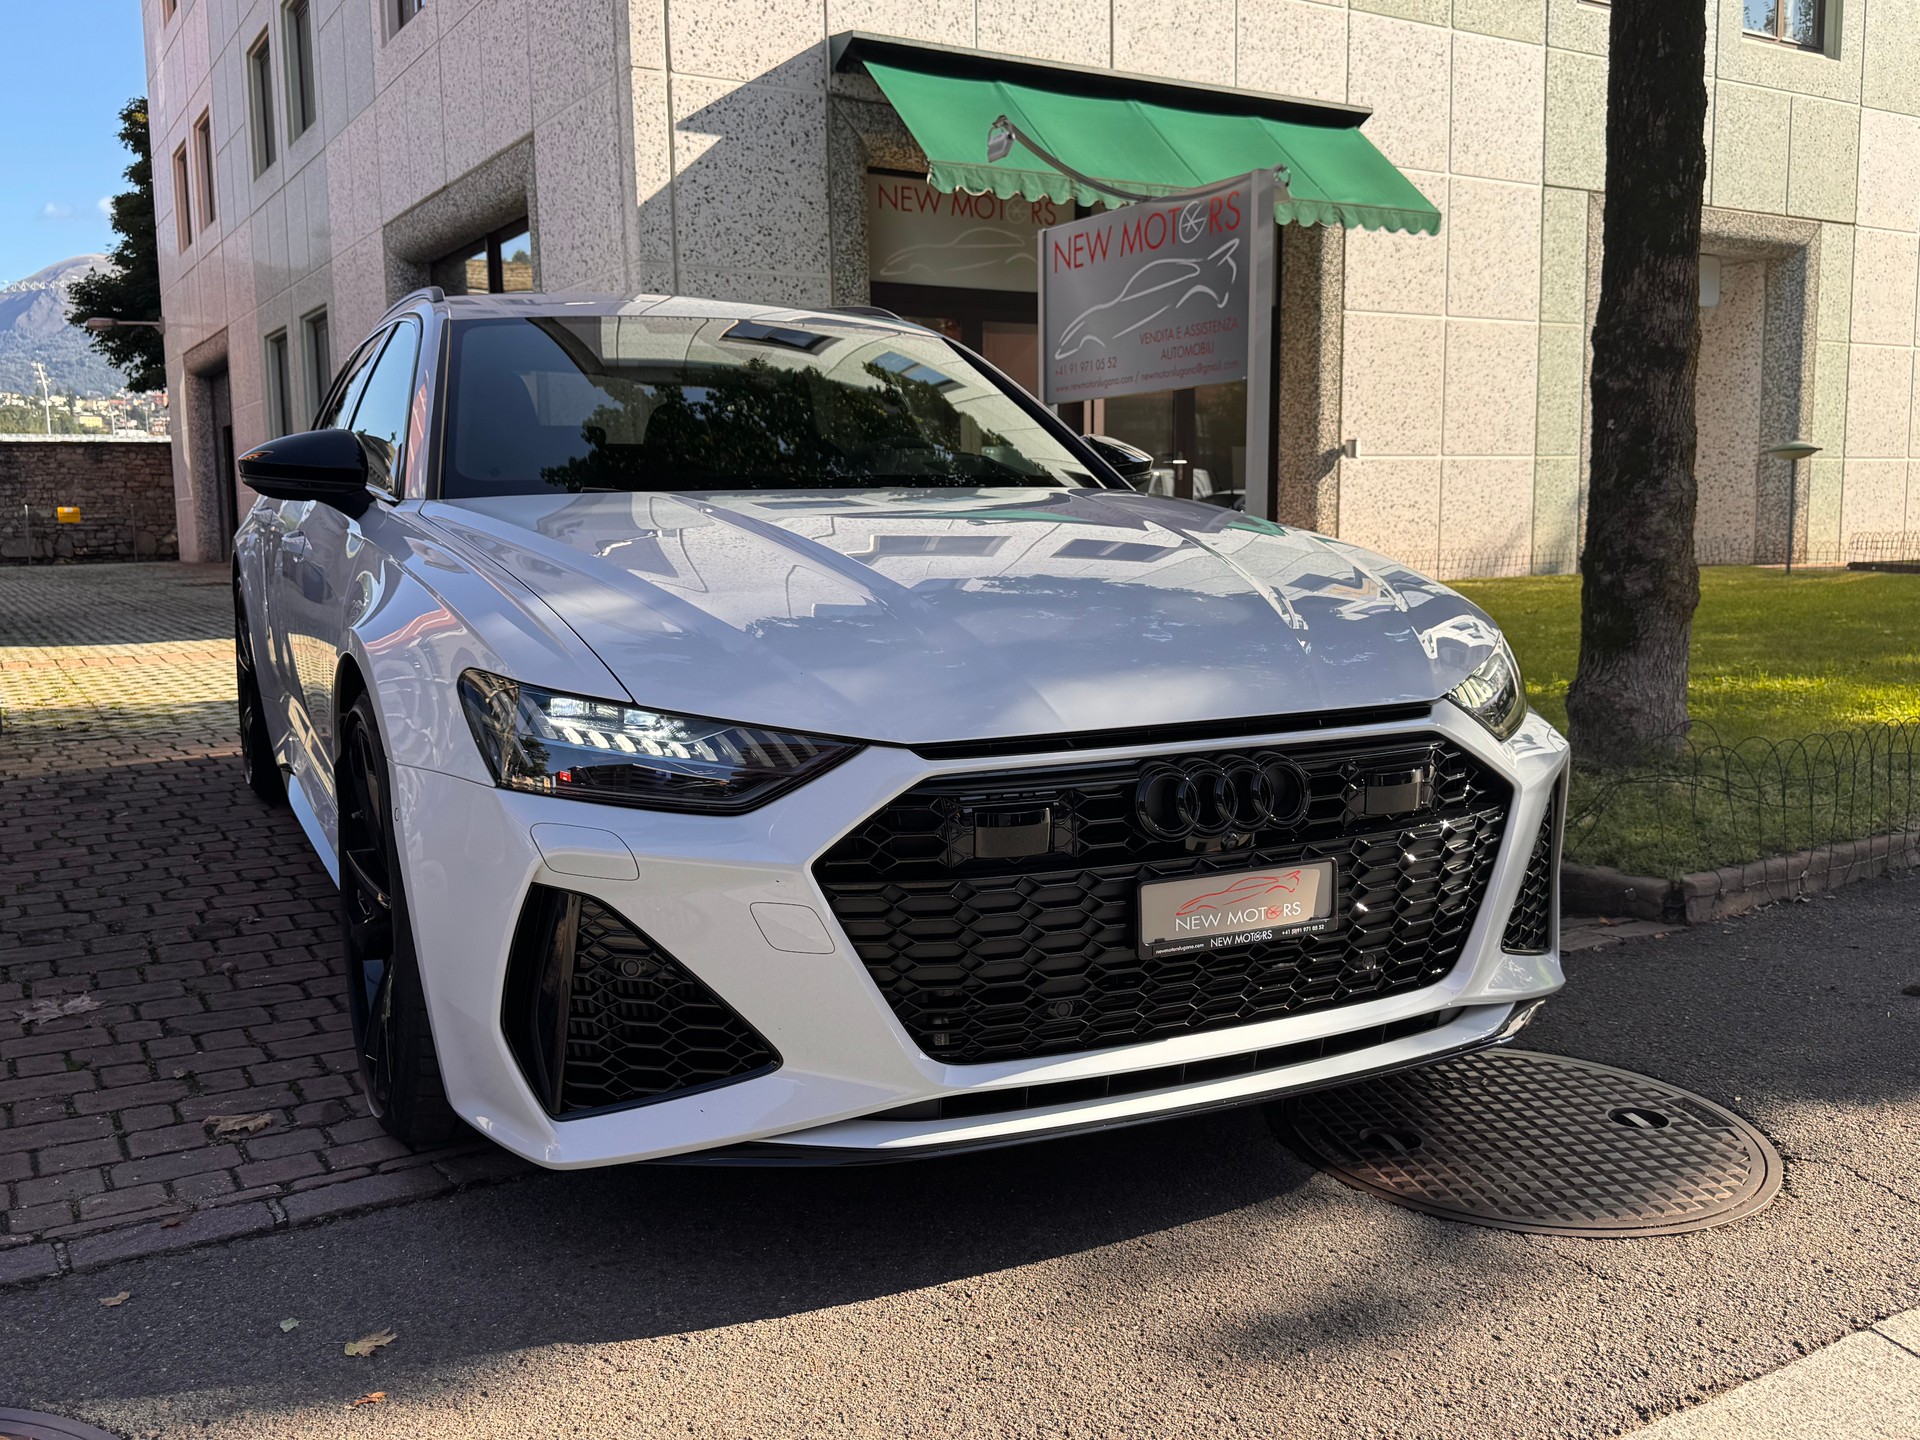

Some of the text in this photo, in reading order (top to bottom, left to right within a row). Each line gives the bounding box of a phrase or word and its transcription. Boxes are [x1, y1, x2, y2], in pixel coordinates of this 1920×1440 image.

[878, 184, 942, 214] NEW
[1054, 191, 1241, 274] NEW MOTORS
[1139, 317, 1240, 345] VENDITA E ASSISTENZA
[1160, 342, 1215, 361] AUTOMOBILI
[1055, 357, 1118, 376] +41 91 971 05 52
[1055, 374, 1134, 392] www.newmotorslugano.com
[1140, 360, 1239, 382] newmotorslugano@gmail.com
[1176, 901, 1302, 932] NEW MOTORS
[1155, 943, 1205, 954] newmotorslugano.com
[1210, 937, 1233, 948] NEW
[1234, 930, 1273, 945] MOTORS
